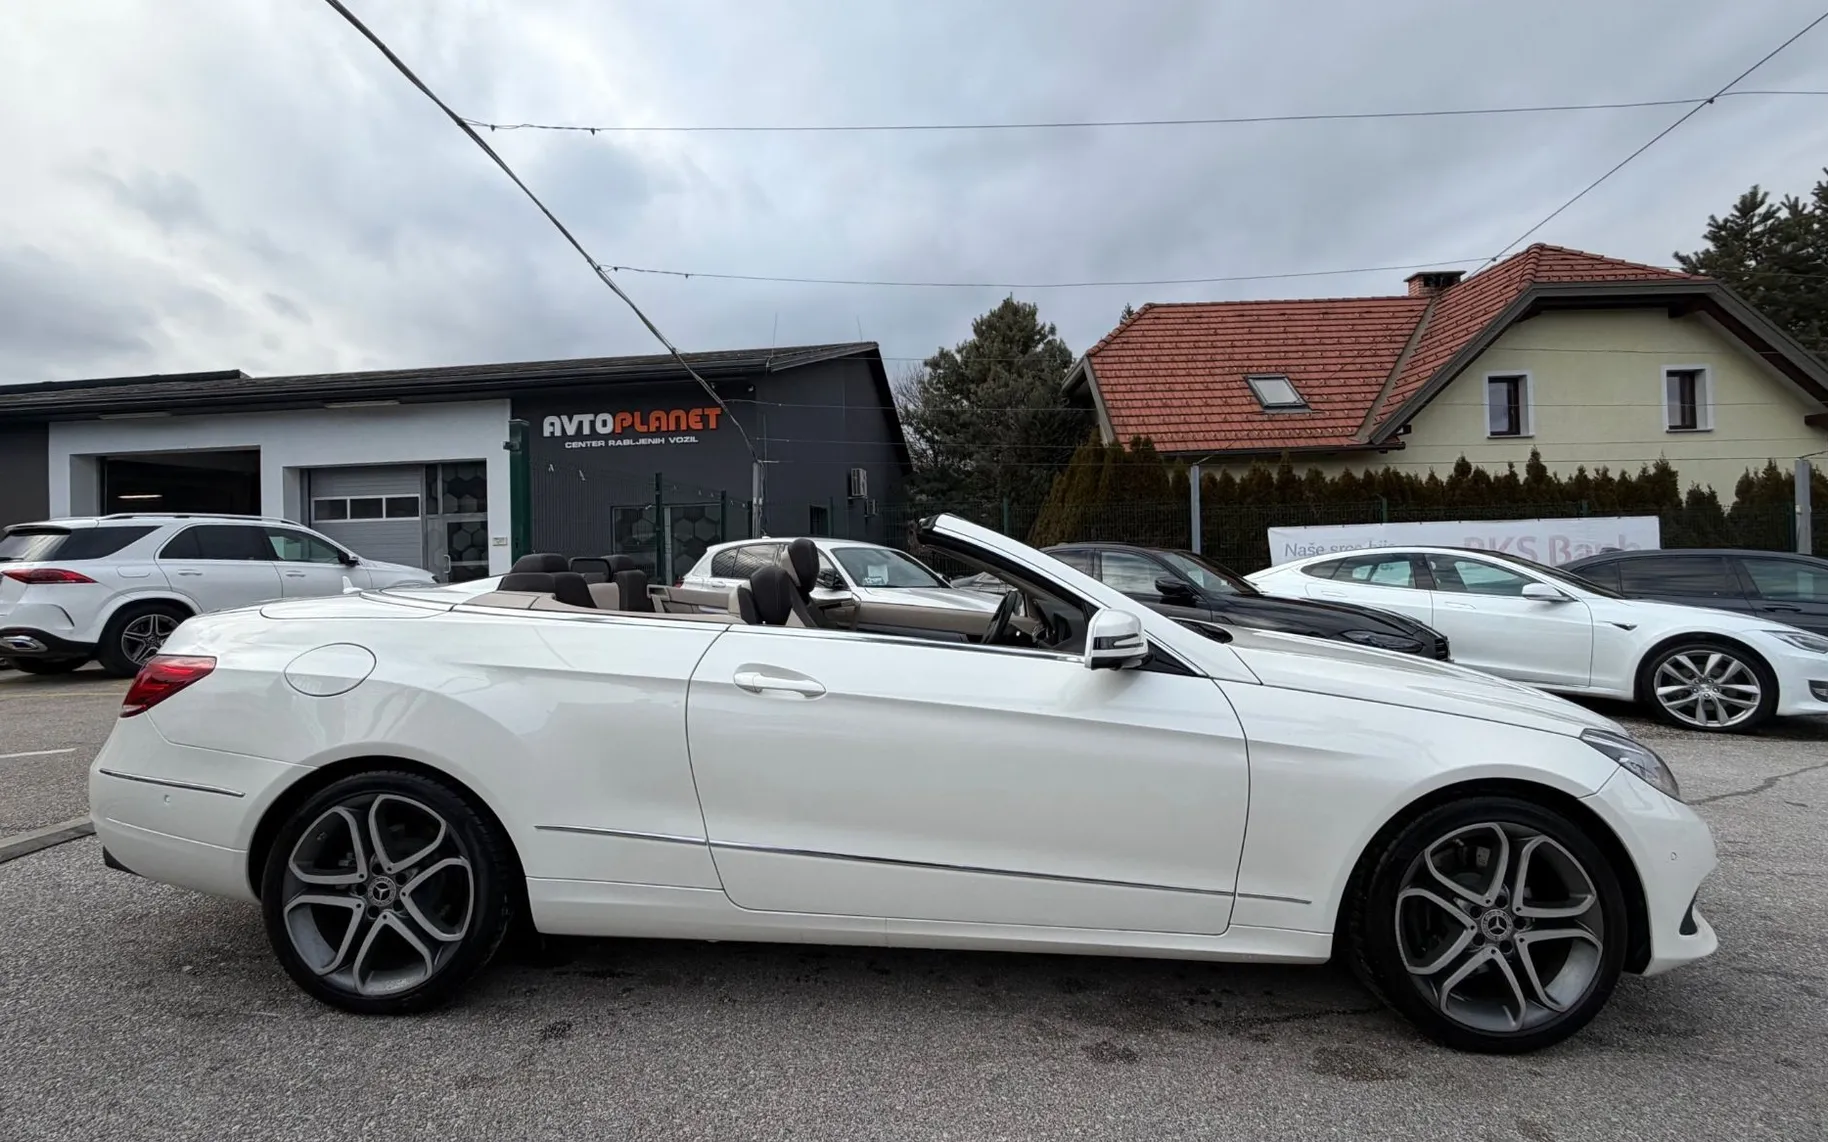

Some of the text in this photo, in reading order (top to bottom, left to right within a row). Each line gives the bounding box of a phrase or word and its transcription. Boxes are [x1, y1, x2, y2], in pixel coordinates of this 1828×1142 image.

[543, 407, 722, 437] AVTOPLANET
[564, 436, 698, 449] CENTER RABLJENIH VOZIL
[1285, 542, 1325, 557] Naše
